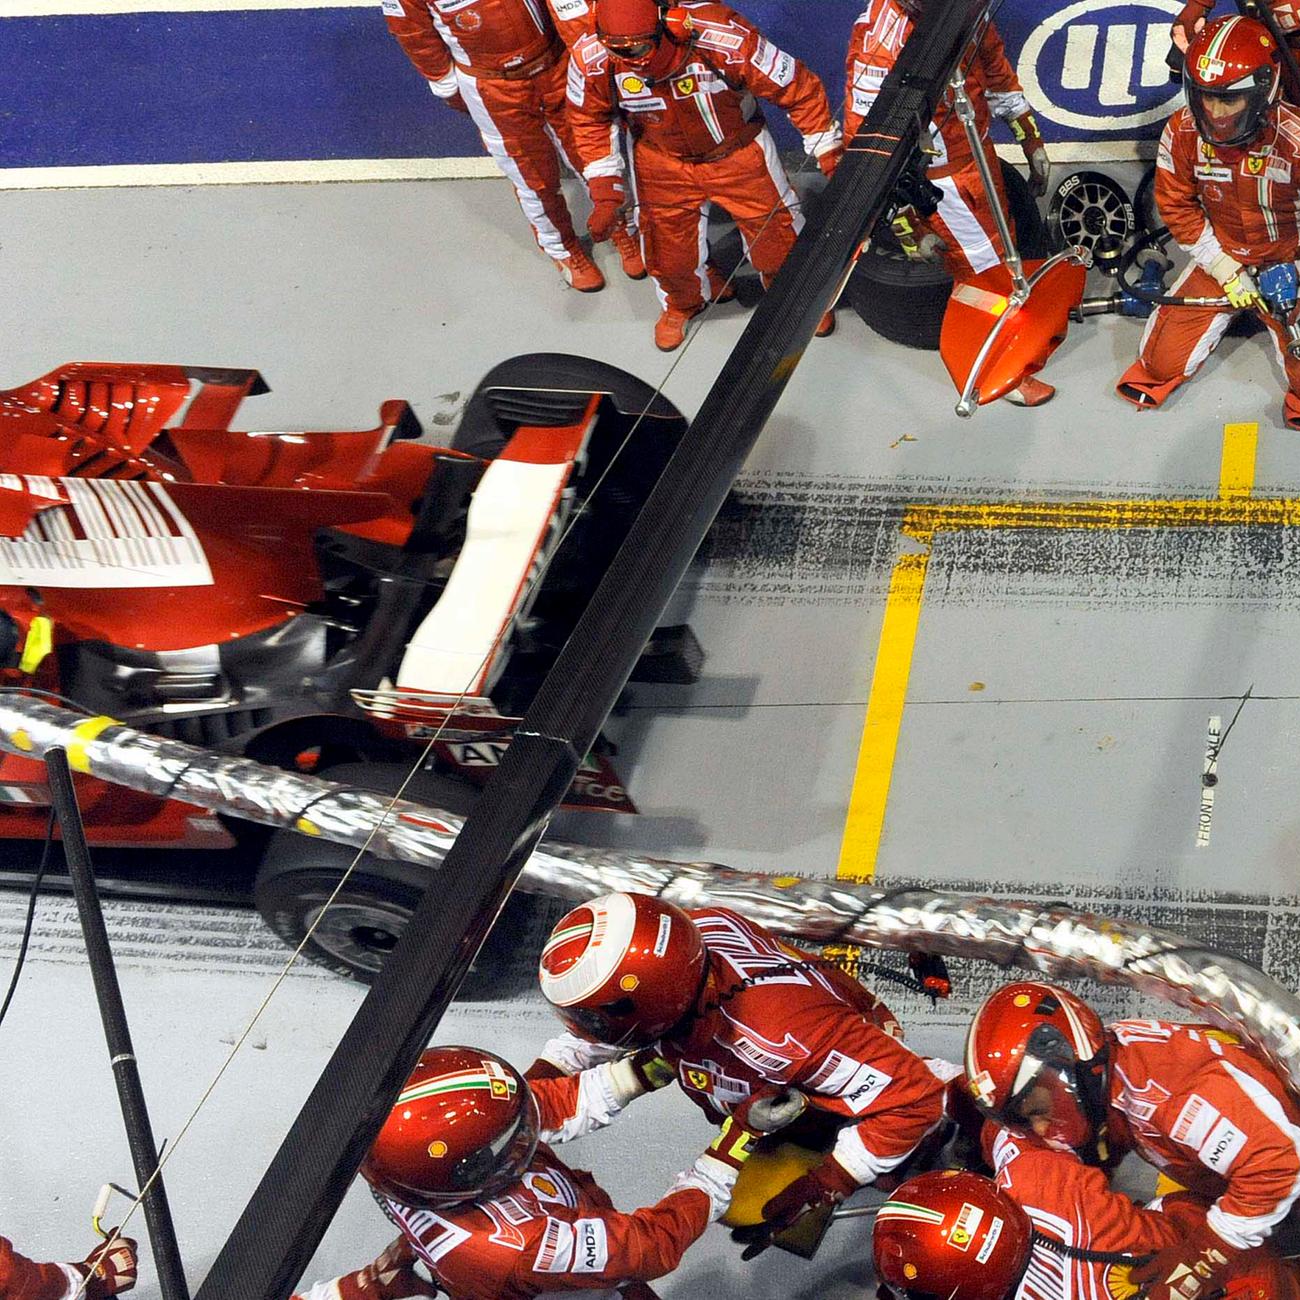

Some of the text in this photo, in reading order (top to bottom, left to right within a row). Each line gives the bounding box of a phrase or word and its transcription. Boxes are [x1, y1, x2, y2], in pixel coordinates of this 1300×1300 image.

[1058, 175, 1081, 198] BBS
[849, 1084, 870, 1103] AMD
[1209, 1140, 1229, 1166] AMD
[585, 1235, 596, 1268] AMD
